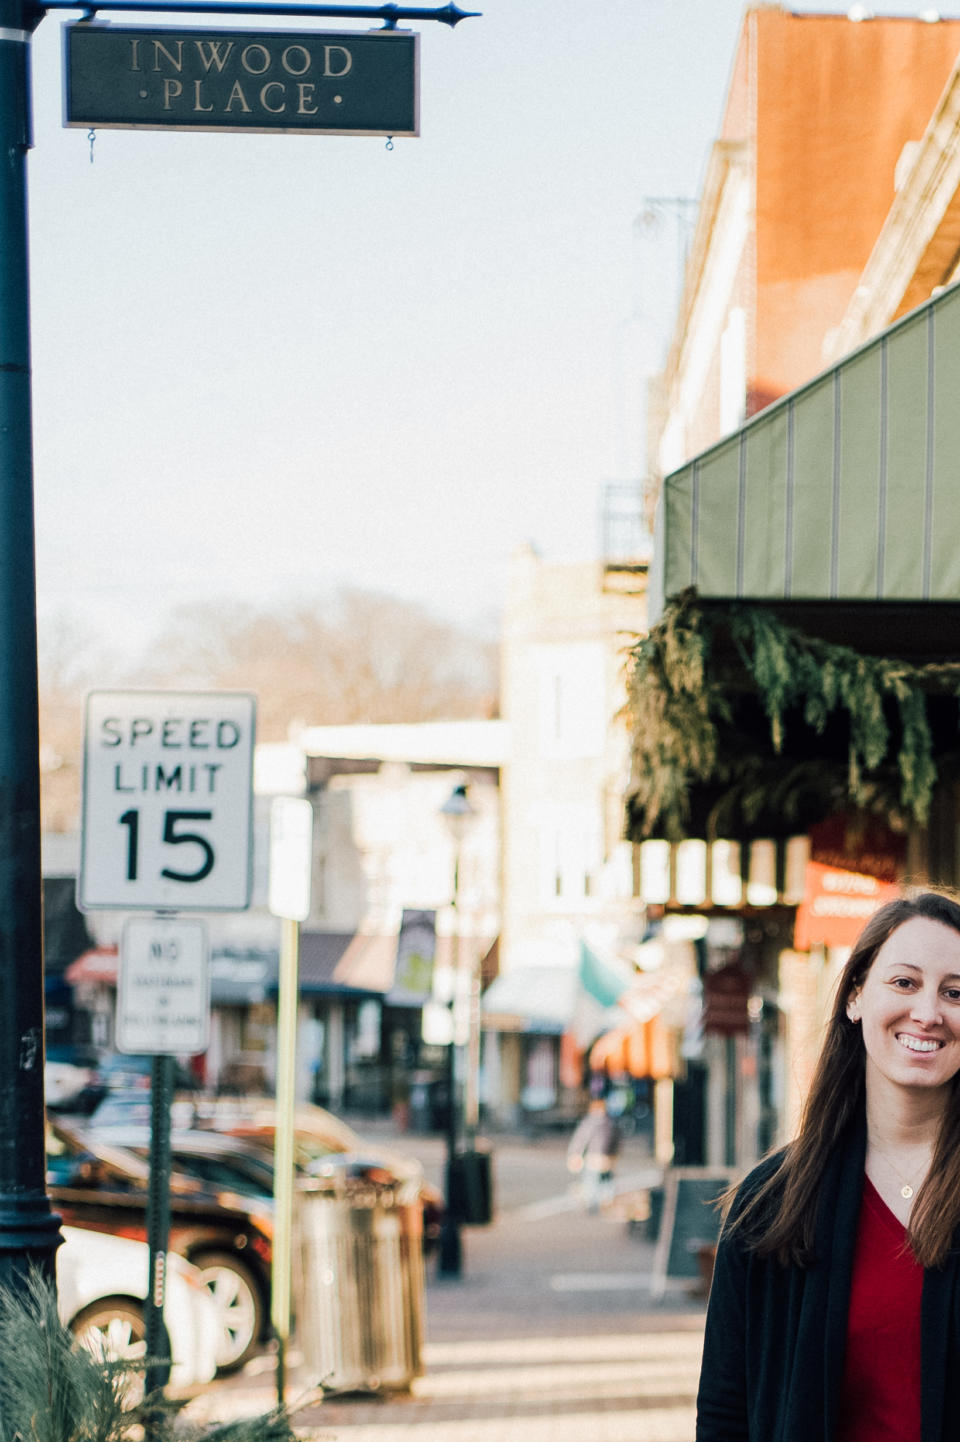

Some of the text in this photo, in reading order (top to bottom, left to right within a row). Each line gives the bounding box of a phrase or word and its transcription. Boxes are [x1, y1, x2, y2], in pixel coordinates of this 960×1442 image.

[130, 39, 353, 77] INWOOD
[163, 78, 319, 115] PLACE
[102, 718, 240, 750] SPEED
[114, 763, 223, 793] LIMIT
[118, 809, 215, 882] 15
